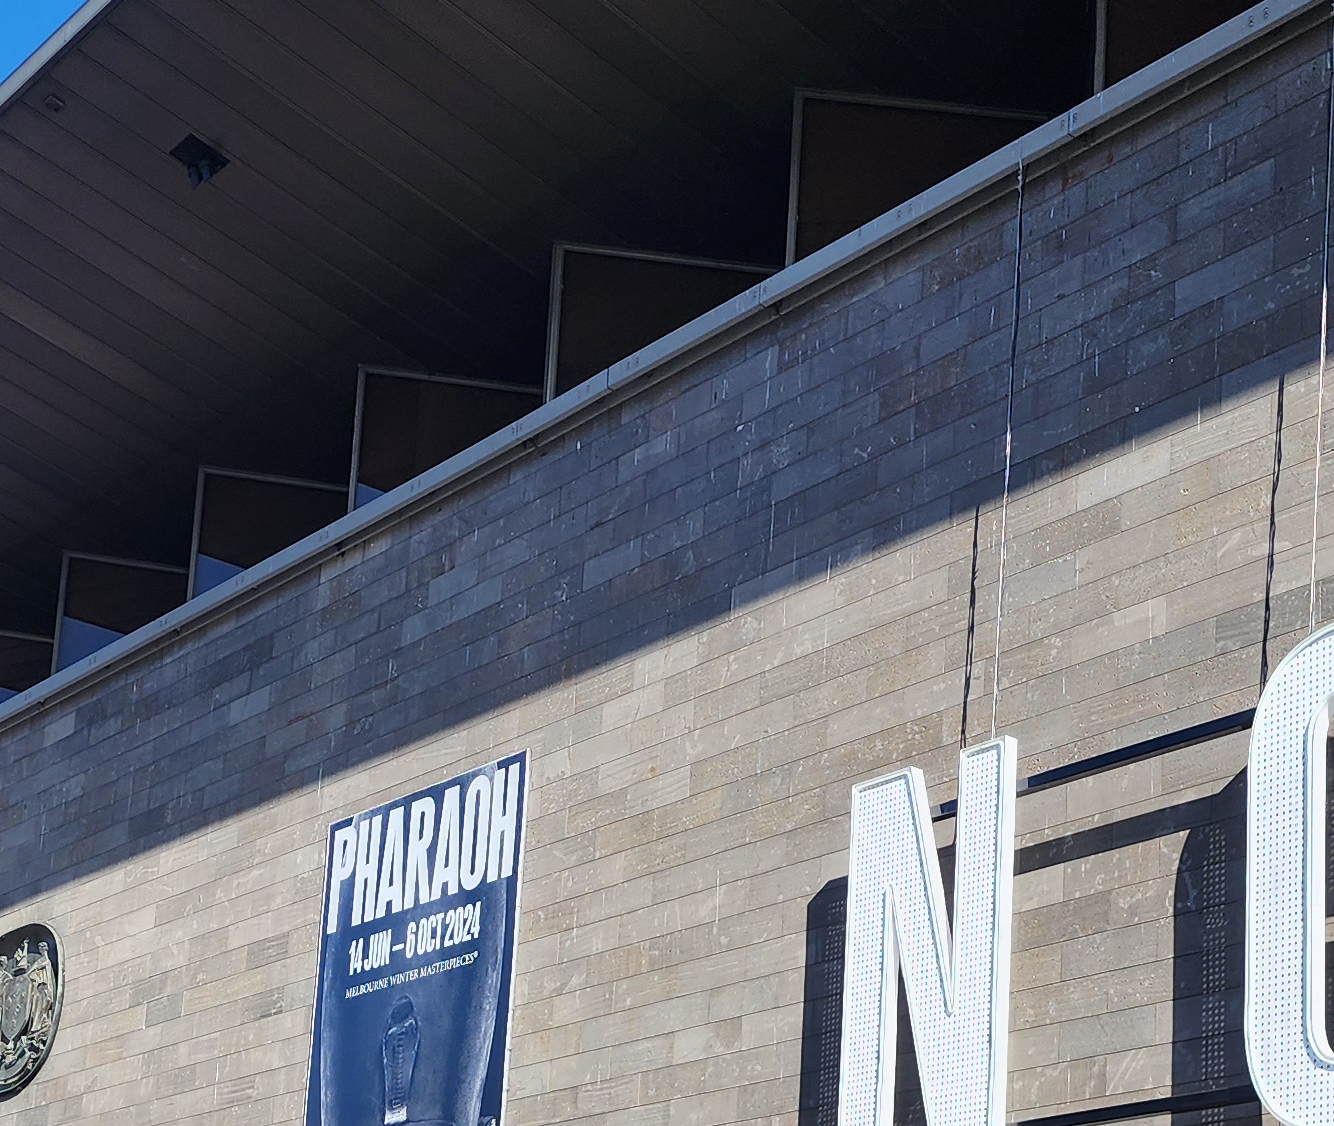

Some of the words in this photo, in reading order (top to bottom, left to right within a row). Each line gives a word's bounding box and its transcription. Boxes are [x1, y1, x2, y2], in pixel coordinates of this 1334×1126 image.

[326, 761, 521, 935] PHARAOH
[349, 938, 363, 976] 14
[364, 929, 392, 971] JUN
[406, 921, 417, 959] 6
[417, 912, 444, 956] OCT
[444, 900, 481, 948] 2024
[345, 977, 389, 999] MELBOURNE
[390, 969, 419, 986] WINTER
